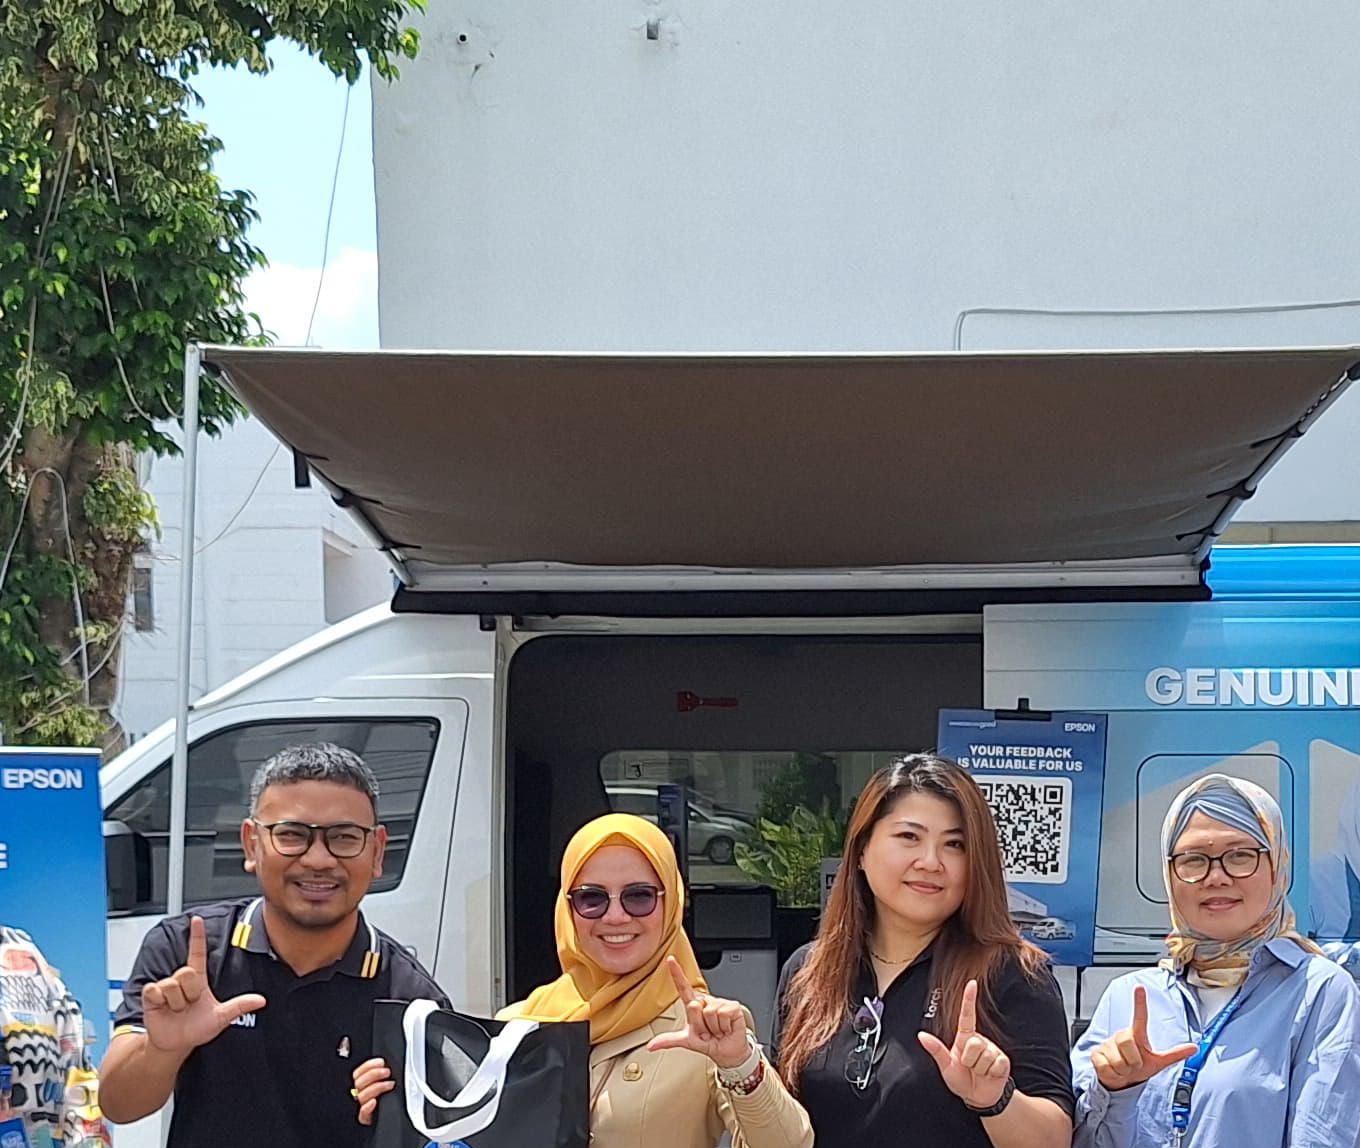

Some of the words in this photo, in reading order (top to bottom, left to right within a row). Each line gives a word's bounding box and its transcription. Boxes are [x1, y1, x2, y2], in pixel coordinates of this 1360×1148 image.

[1064, 722, 1096, 733] EPSON
[970, 745, 1004, 758] YOUR
[1005, 747, 1072, 759] FEEDBACK
[972, 758, 1037, 770] VALUABLE
[1039, 759, 1063, 771] FOR
[1065, 760, 1083, 772] US
[1, 767, 83, 789] EPSON
[230, 1012, 257, 1028] ON
